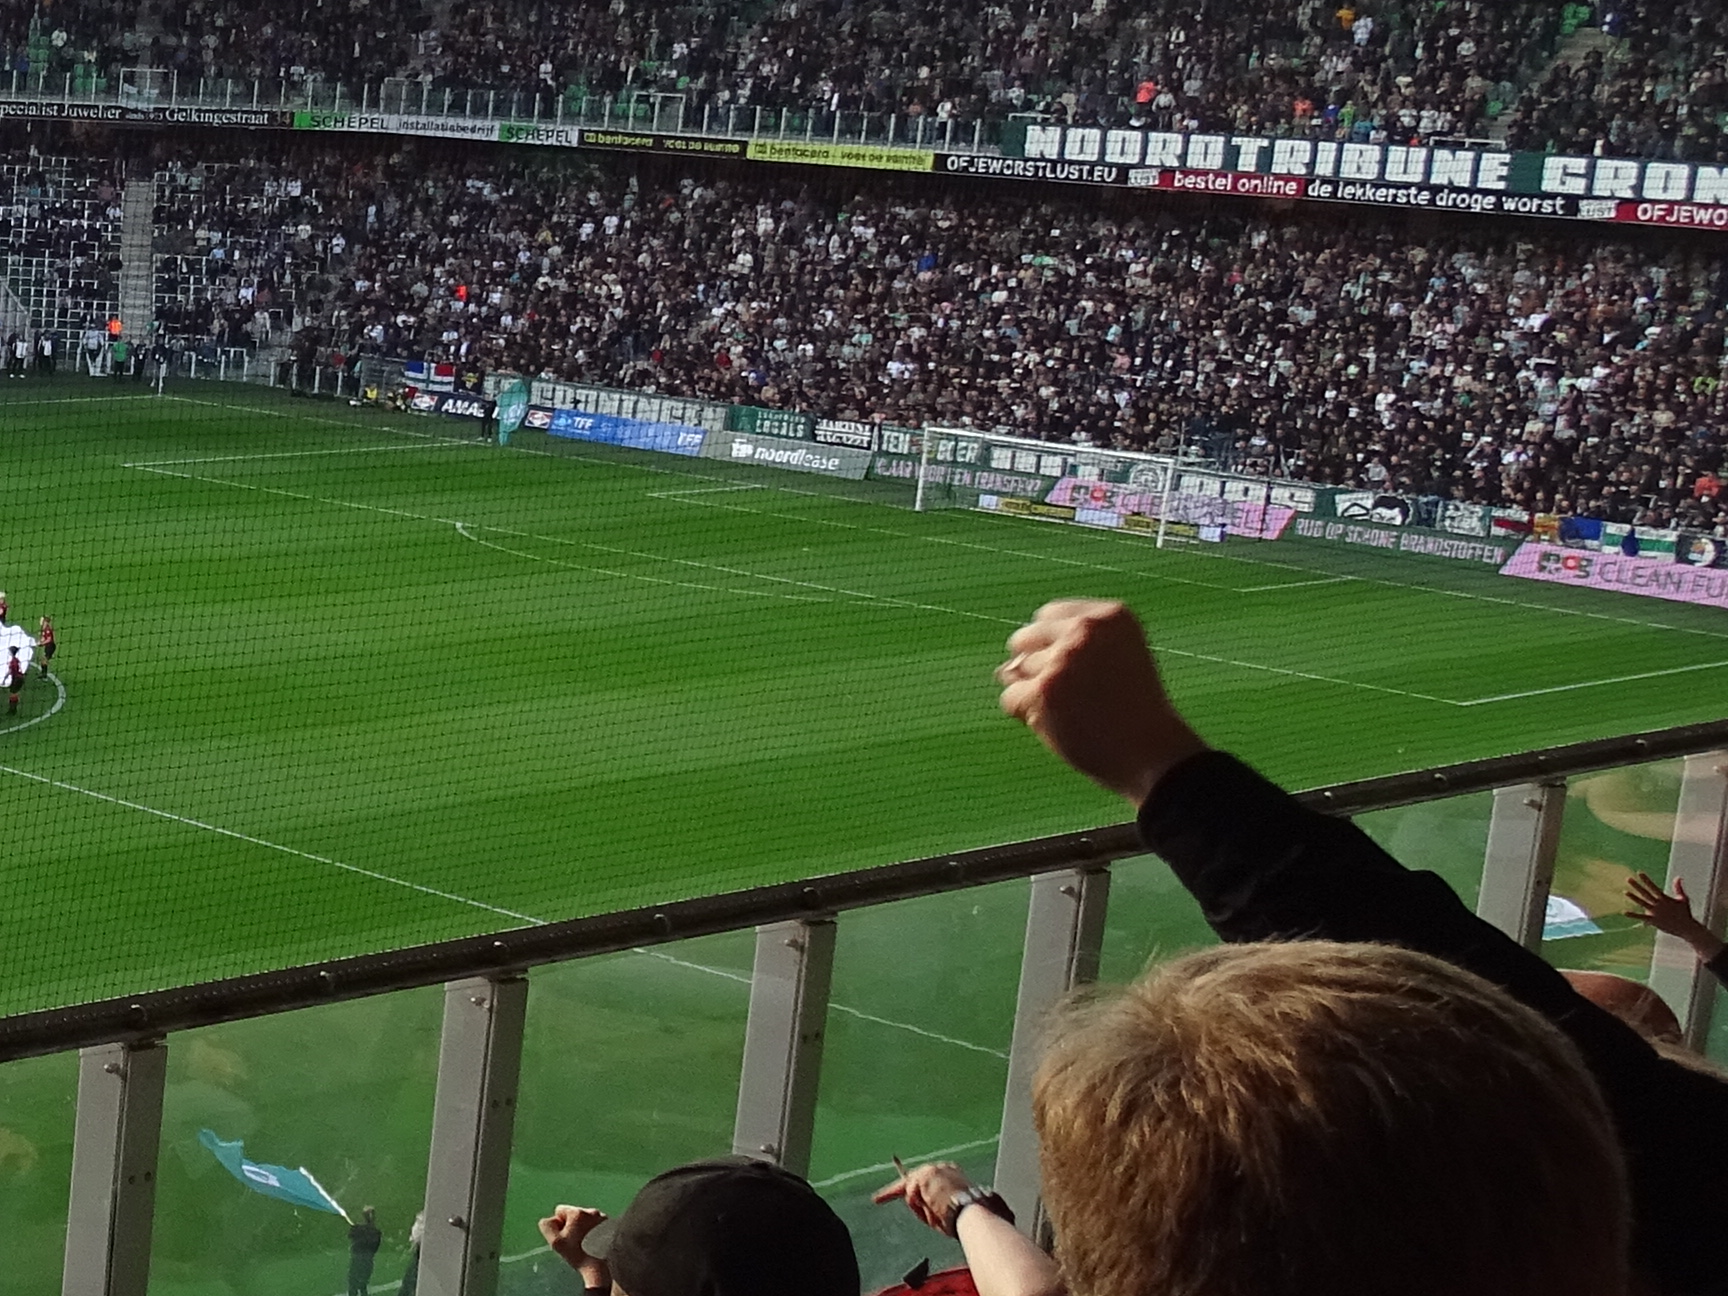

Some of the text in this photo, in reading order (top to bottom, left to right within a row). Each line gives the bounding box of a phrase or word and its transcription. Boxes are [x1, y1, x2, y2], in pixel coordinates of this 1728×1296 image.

[60, 102, 122, 120] Juwelier
[310, 114, 389, 130] SCHEPEL
[506, 126, 572, 144] SCHEPEL
[947, 155, 1117, 183] OFJEWORSTLUST.EU
[1173, 170, 1565, 215] bestel online de lekkerste droge worst
[1636, 202, 1728, 226] OFJEWO
[881, 429, 910, 454] TEN
[755, 447, 840, 470] noordlease
[1694, 573, 1728, 601] FU
